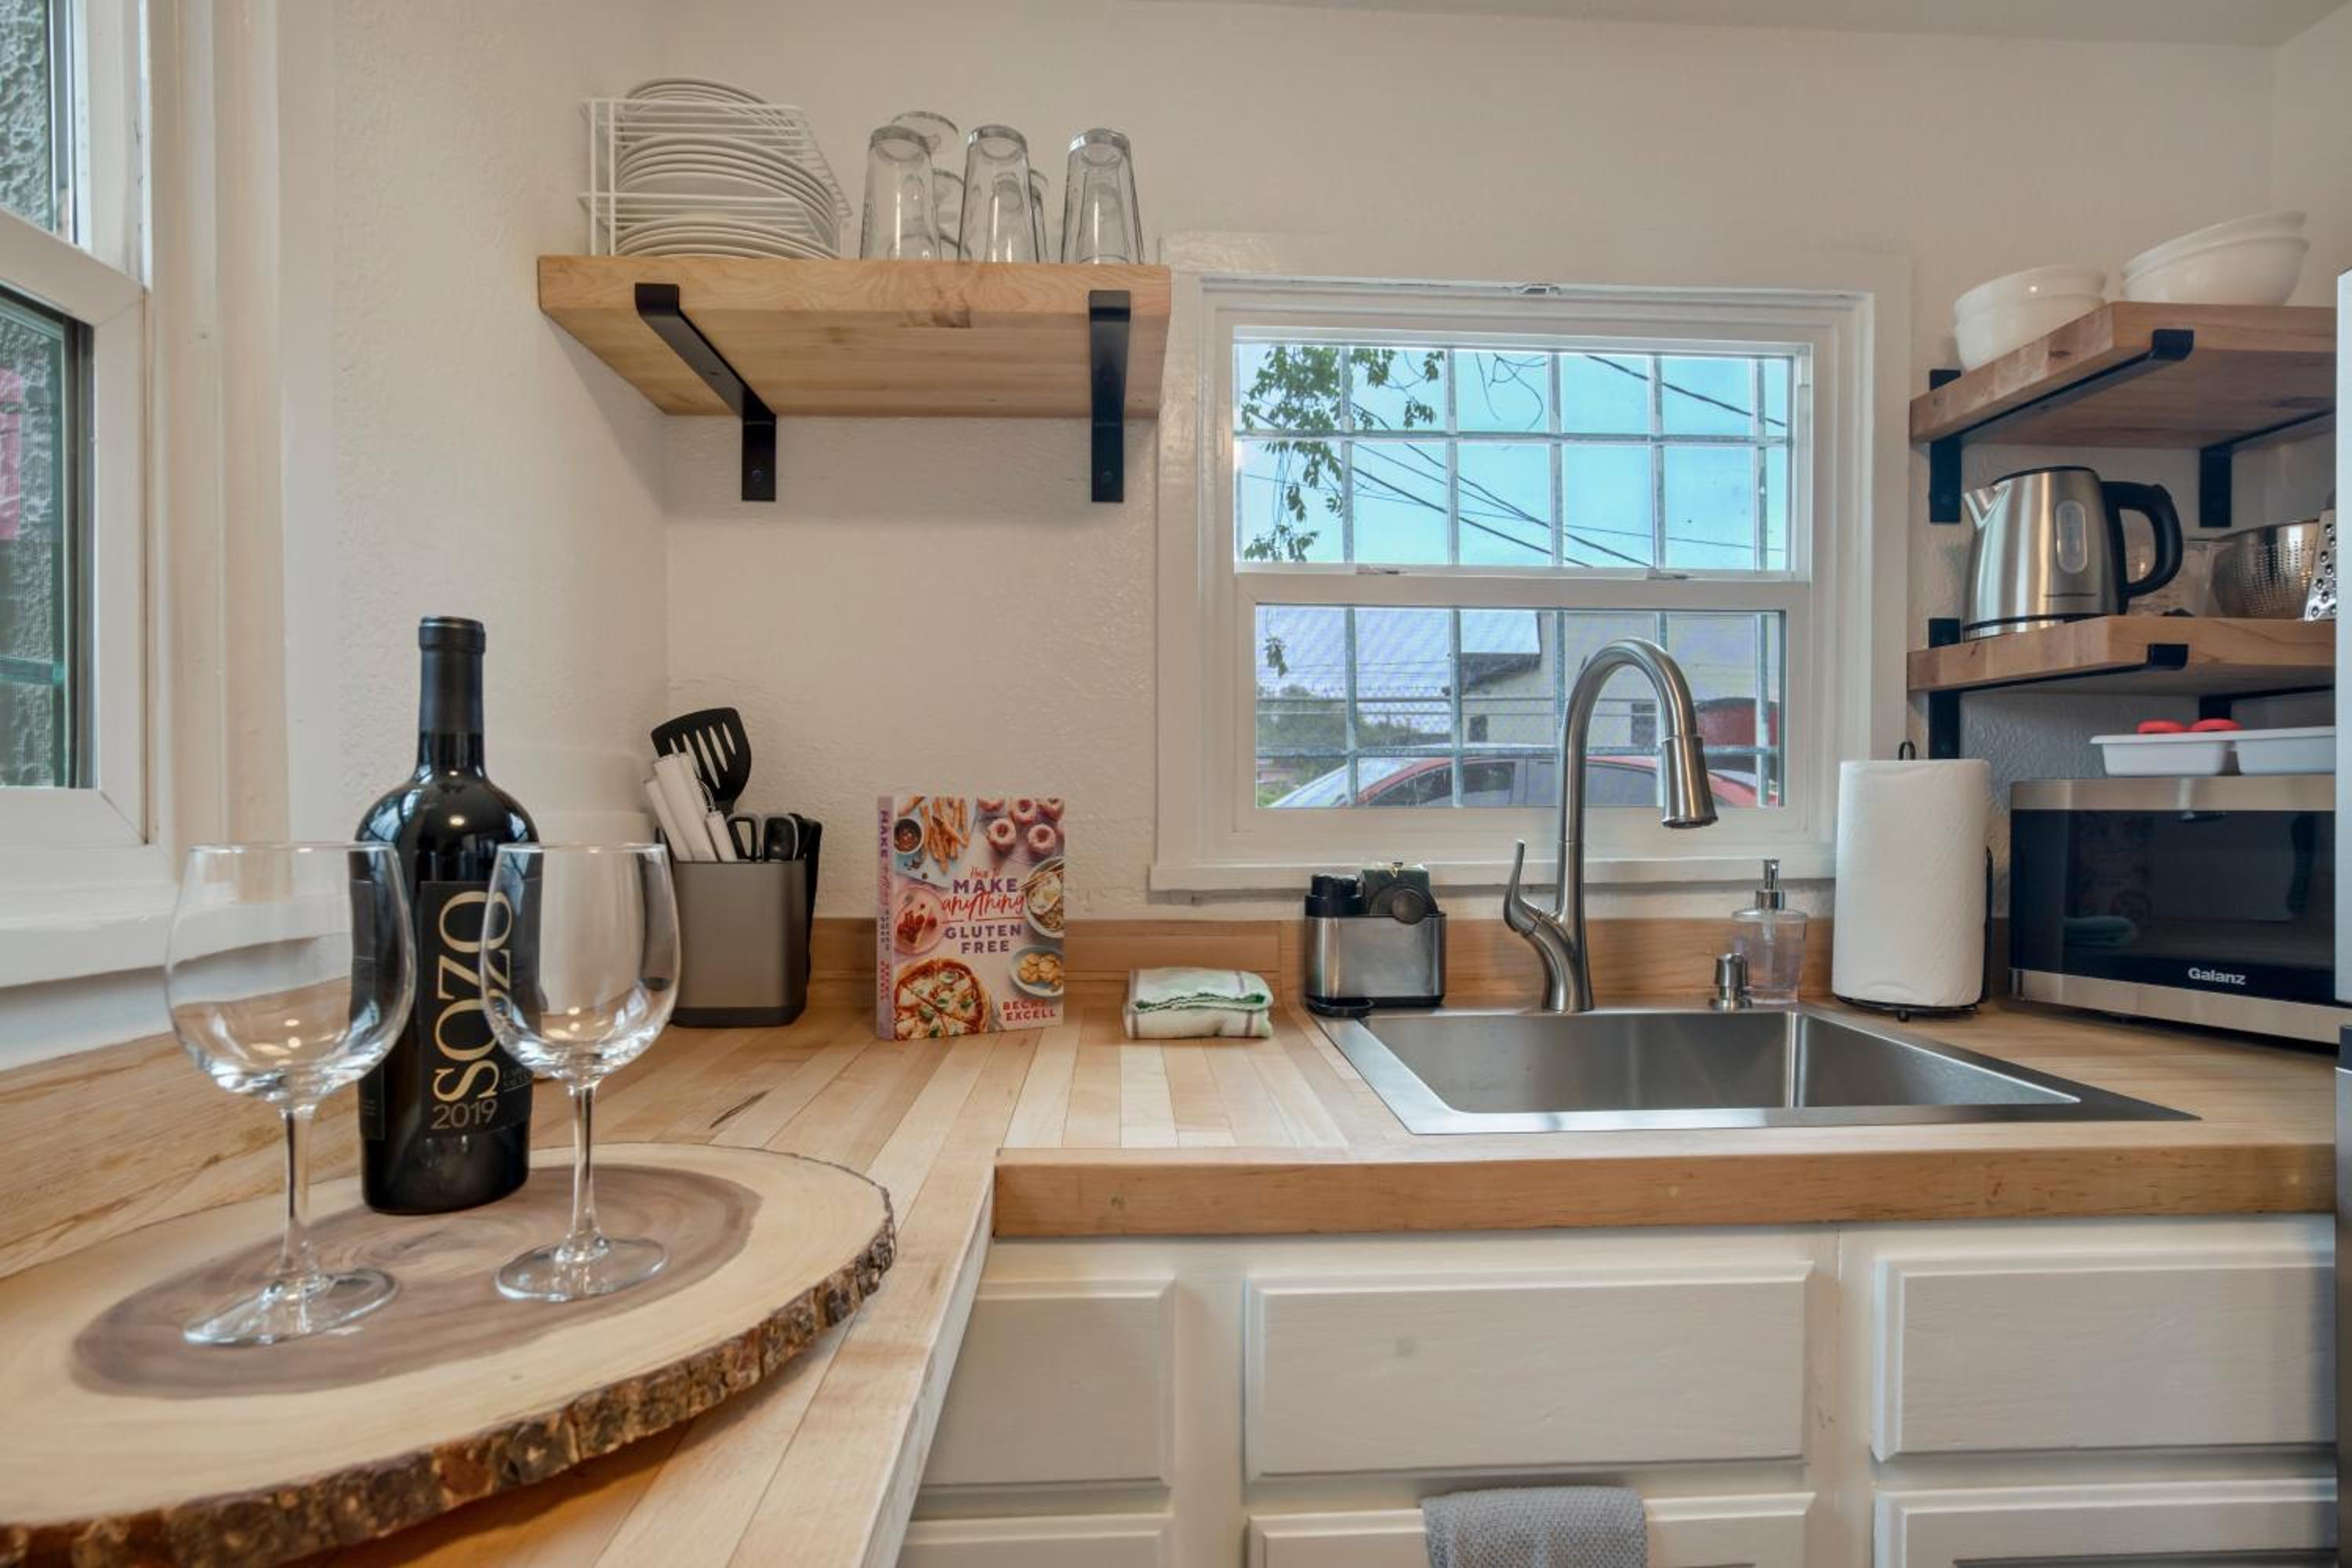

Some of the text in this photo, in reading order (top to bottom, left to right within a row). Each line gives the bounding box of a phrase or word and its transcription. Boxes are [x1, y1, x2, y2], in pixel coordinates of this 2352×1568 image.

[953, 878, 1018, 894] MAKE
[941, 890, 1025, 921] anything
[945, 925, 1022, 939] GLUTEN
[960, 940, 1010, 954] FREE
[2187, 967, 2246, 985] Galanz
[432, 891, 513, 1102] SOZO
[1006, 1009, 1055, 1021] EXCELL
[431, 1098, 498, 1129] 2019
